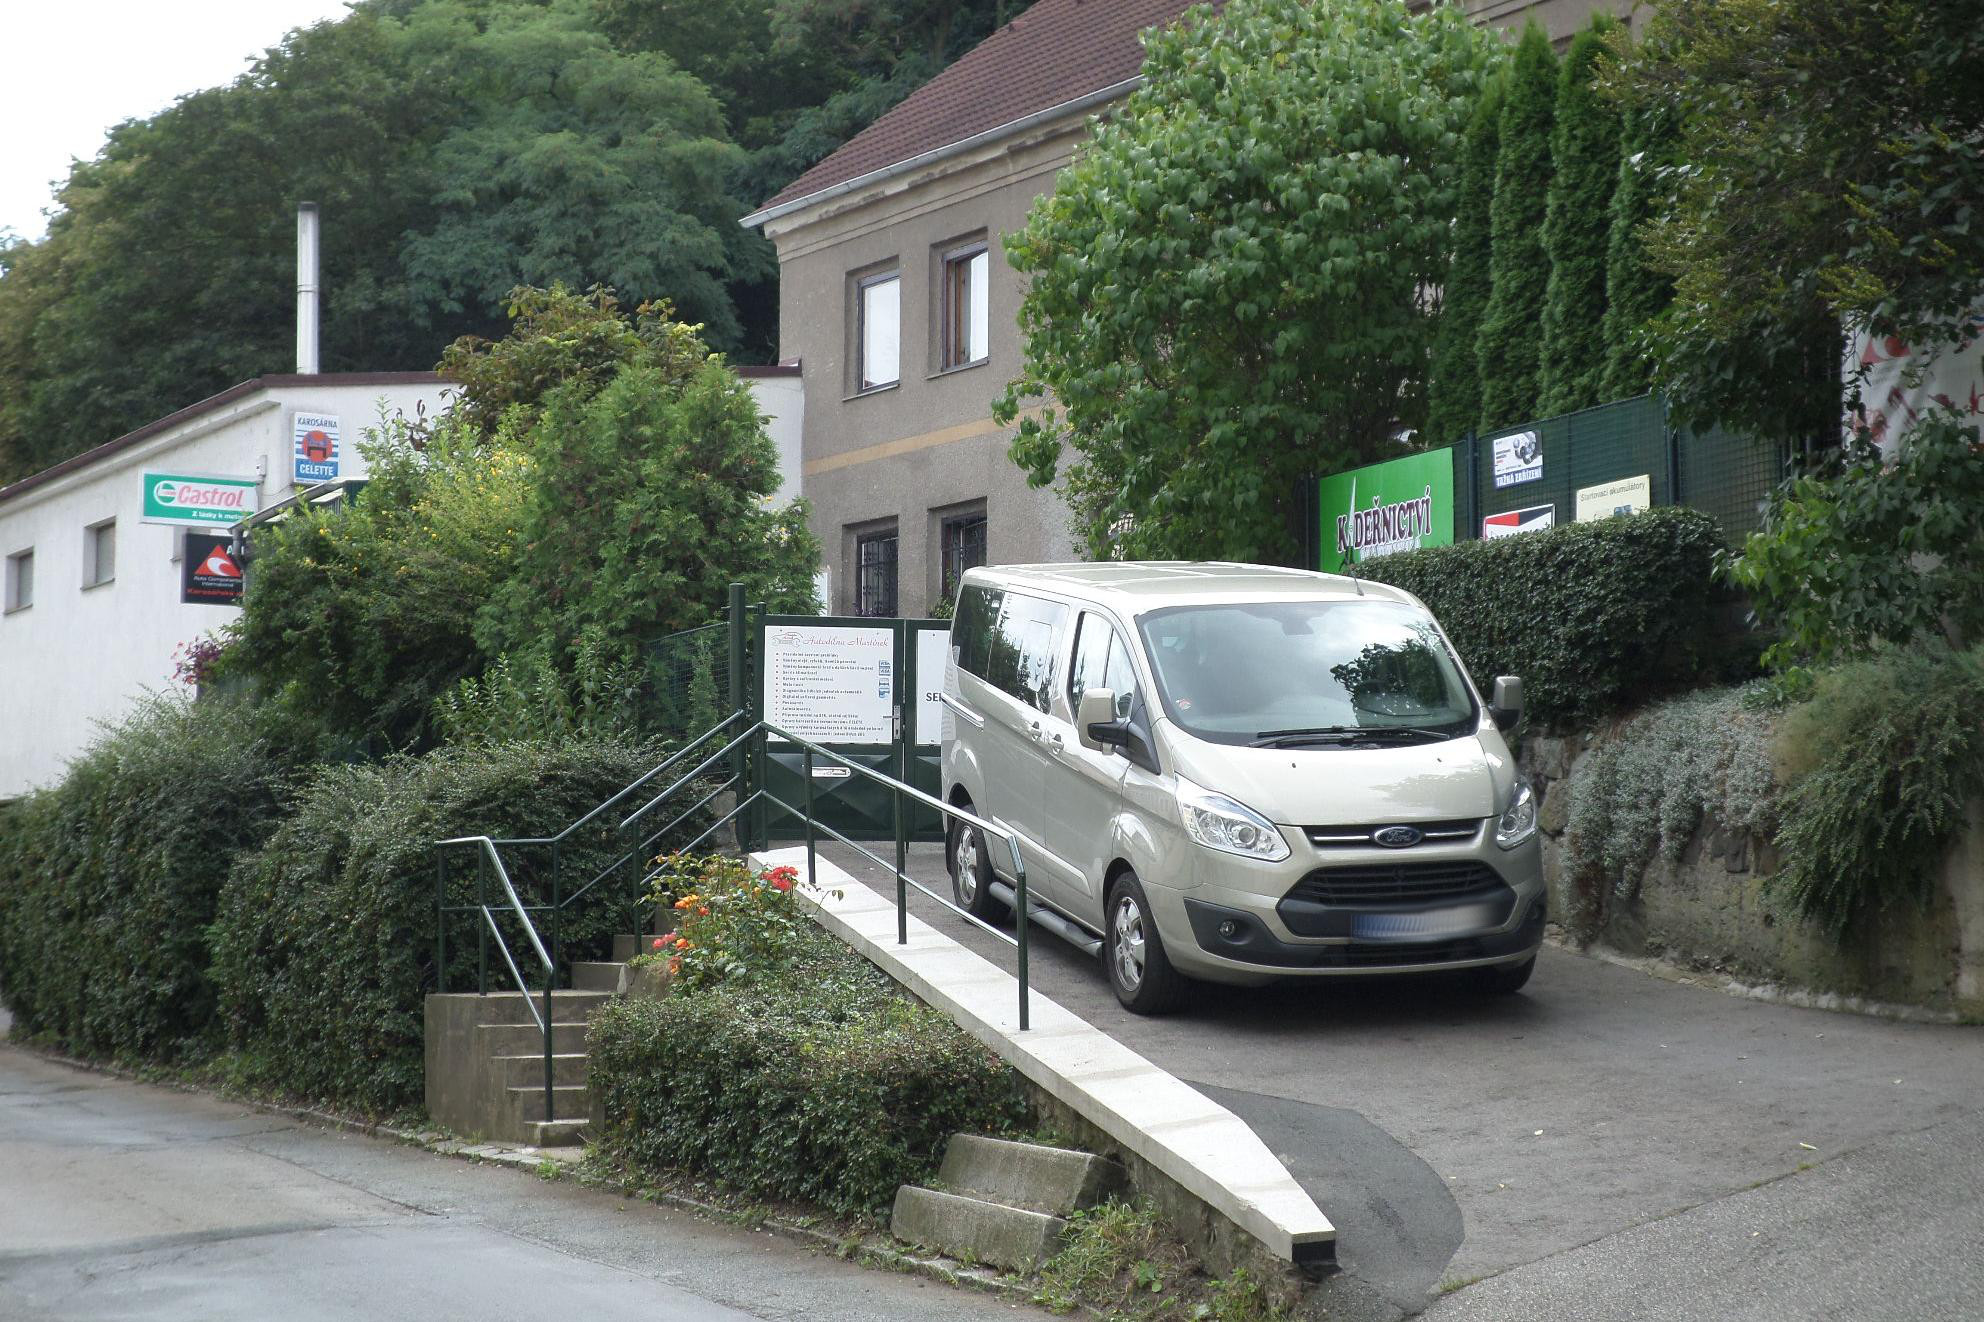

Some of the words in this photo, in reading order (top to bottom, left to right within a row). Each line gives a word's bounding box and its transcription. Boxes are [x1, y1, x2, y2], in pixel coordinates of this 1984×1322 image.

[300, 463, 334, 476] CELETTE
[178, 485, 244, 506] Castrol
[1387, 829, 1412, 841] Ford
